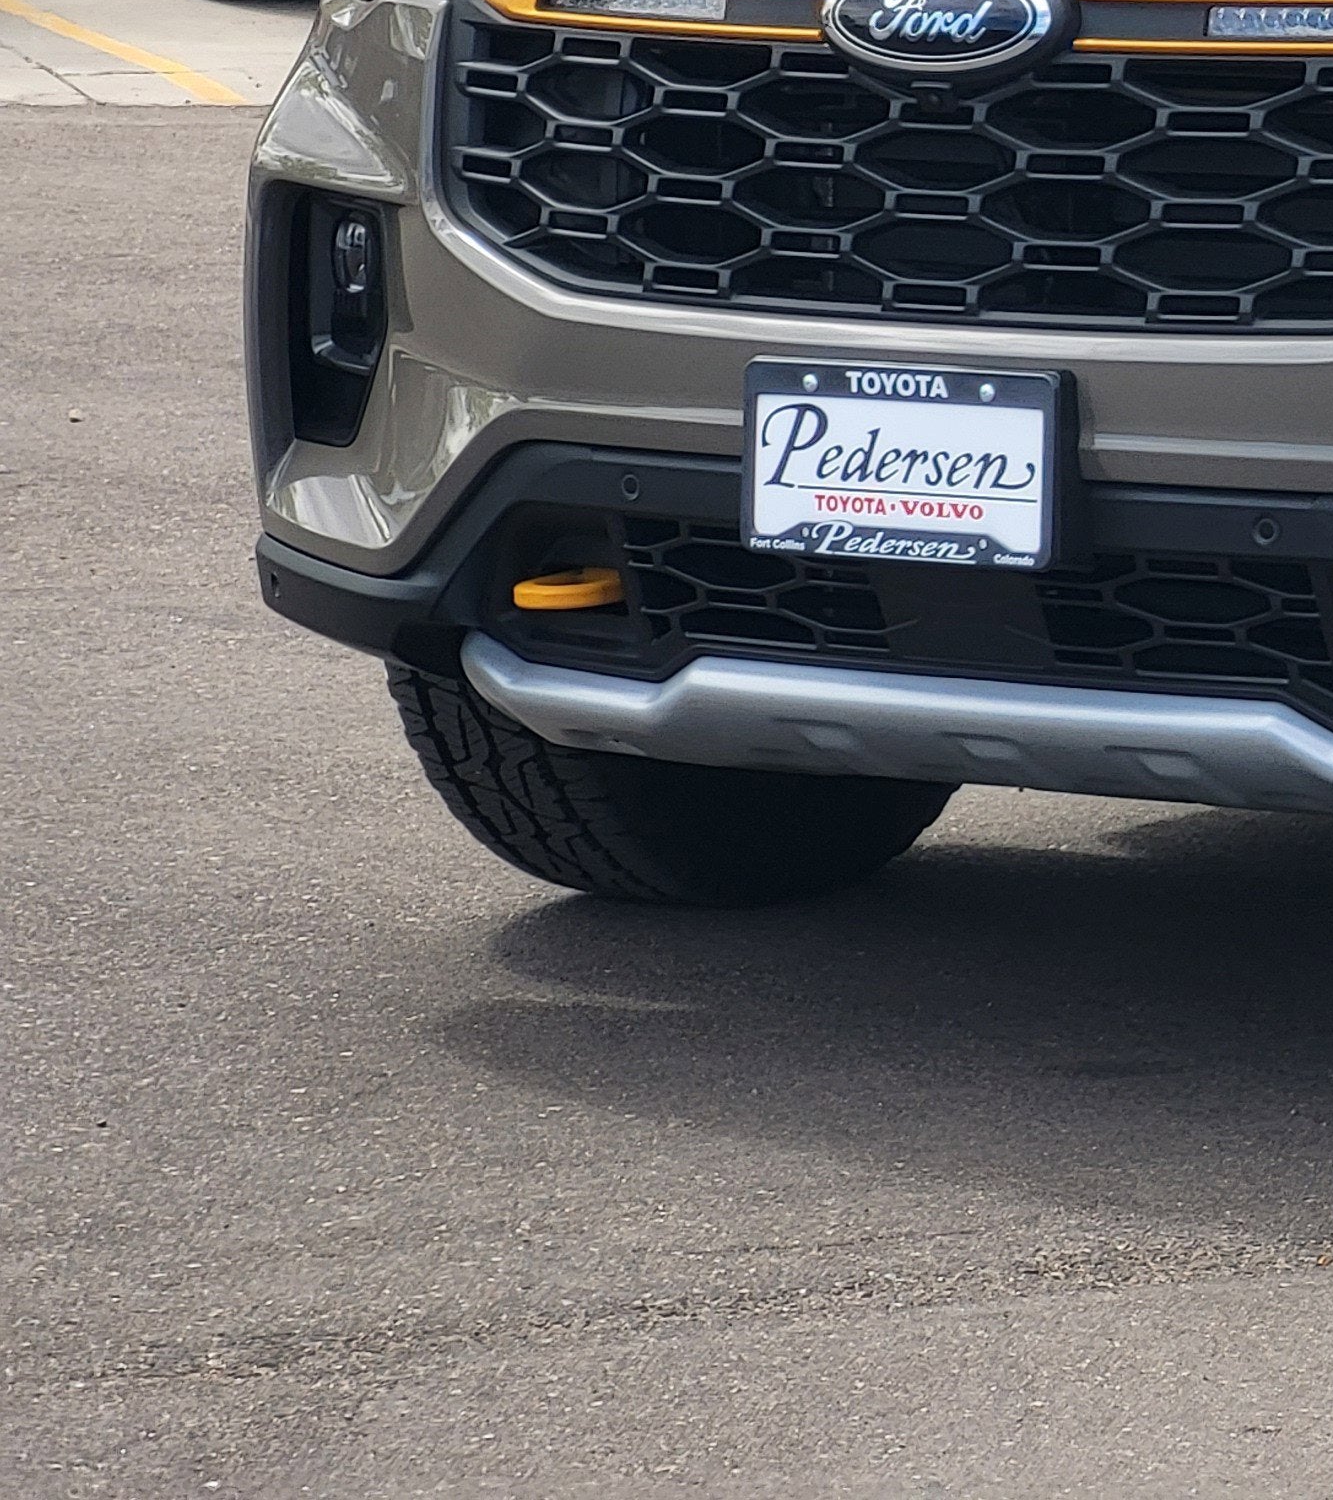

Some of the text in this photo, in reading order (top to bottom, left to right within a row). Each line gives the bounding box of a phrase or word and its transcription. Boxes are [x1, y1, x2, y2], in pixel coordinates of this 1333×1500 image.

[845, 371, 950, 398] TOYOTA
[761, 403, 1036, 490] Pedersen
[814, 494, 985, 521] TOYOTA VOLVO
[750, 537, 806, 551] Fort Collins
[811, 520, 977, 562] Pedersen
